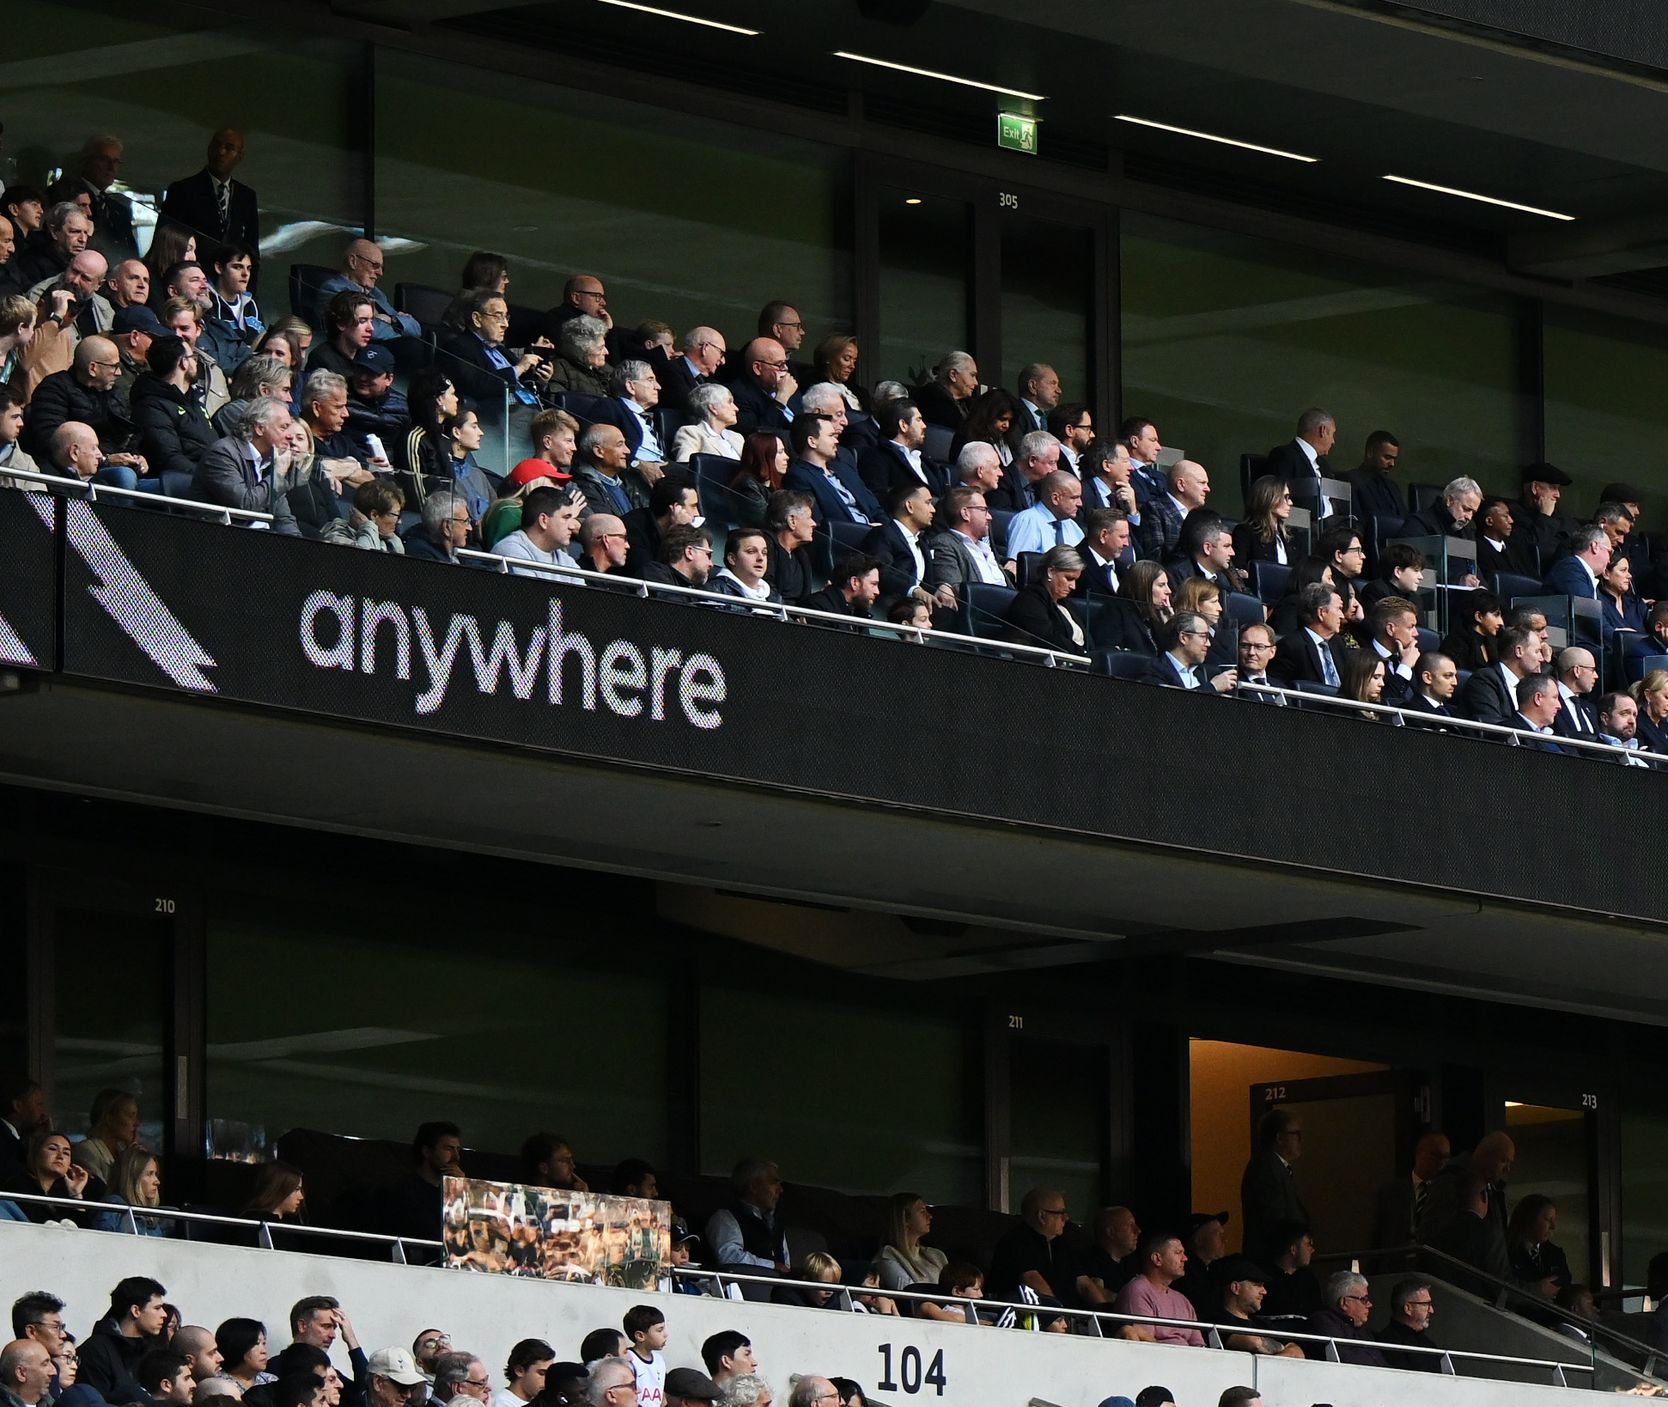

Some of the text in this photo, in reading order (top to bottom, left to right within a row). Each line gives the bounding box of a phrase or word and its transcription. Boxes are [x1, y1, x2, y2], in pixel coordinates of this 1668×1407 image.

[1003, 125, 1020, 139] Exit
[1000, 192, 1018, 210] 305
[300, 590, 726, 729] anywhere
[155, 897, 176, 914] 210
[1008, 1015, 1023, 1029] 211
[1265, 1087, 1287, 1100] 212
[1582, 1094, 1598, 1109] 213
[877, 1343, 946, 1396] 104
